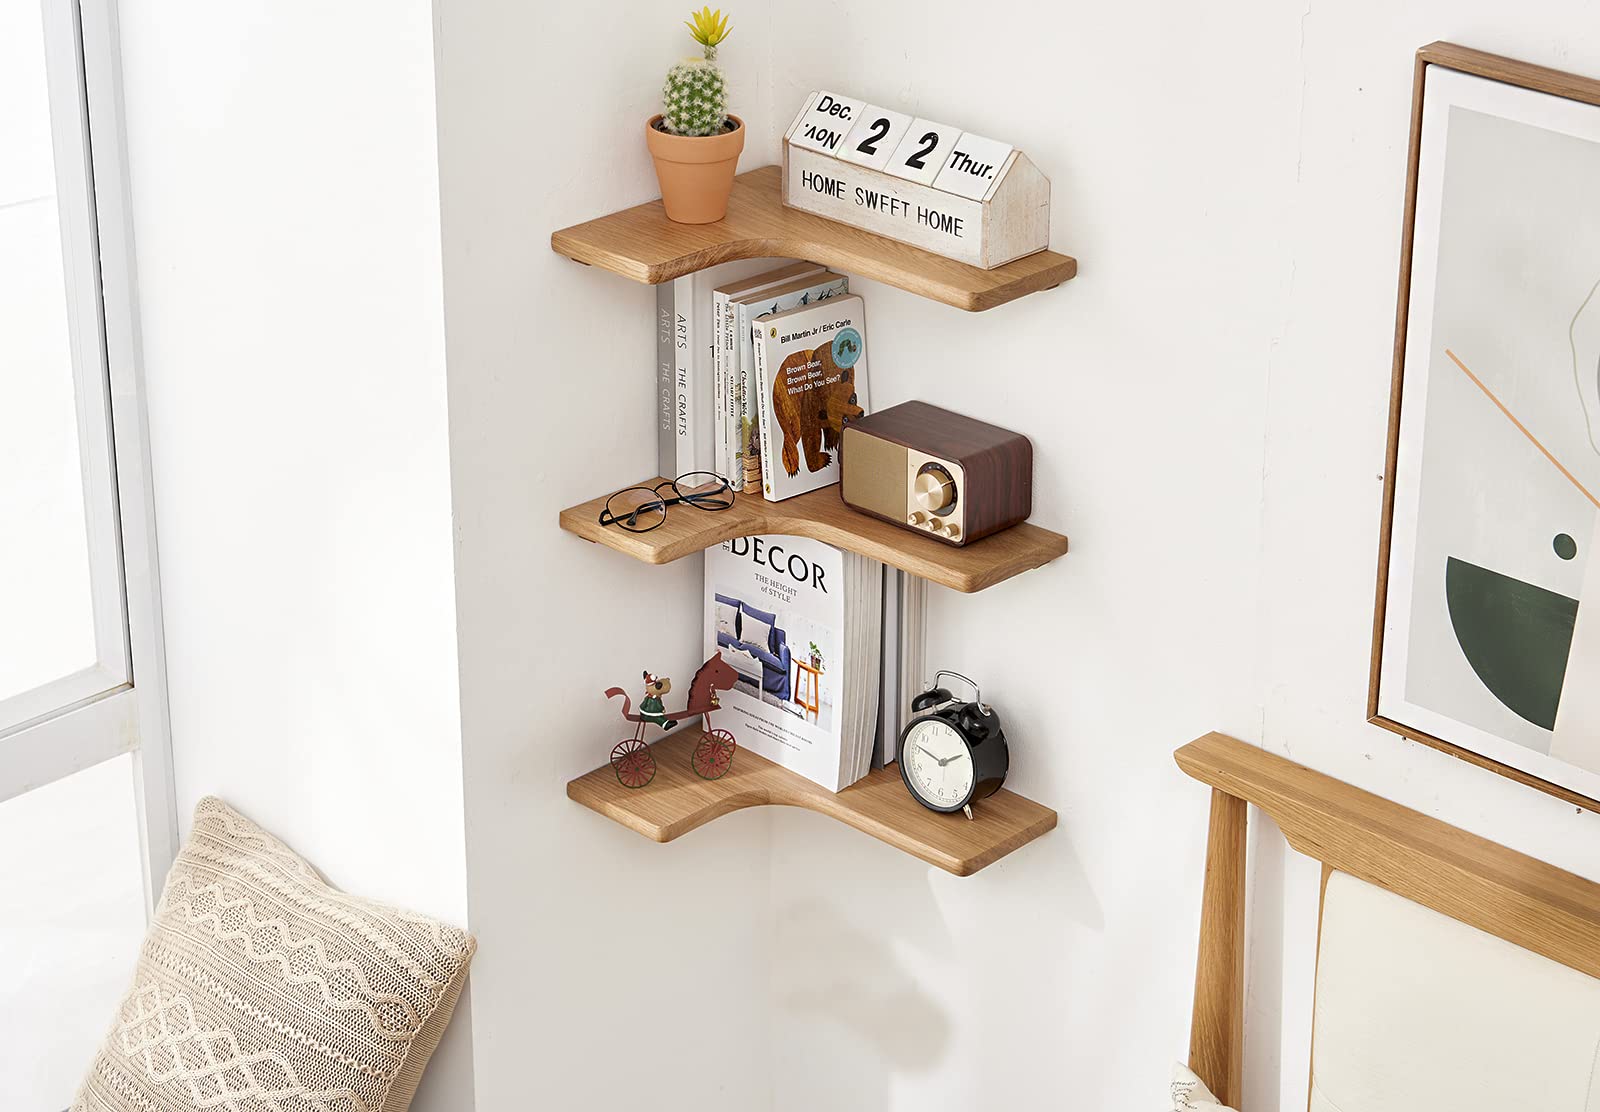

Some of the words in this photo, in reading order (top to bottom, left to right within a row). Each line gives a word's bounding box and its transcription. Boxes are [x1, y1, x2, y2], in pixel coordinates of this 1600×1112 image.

[816, 95, 852, 121] Dec.
[804, 123, 842, 150] Nov.
[856, 118, 890, 156] 2
[904, 132, 939, 170] 2
[949, 151, 993, 180] Thur.
[802, 170, 847, 200] HOME
[917, 206, 964, 238] HOME
[661, 307, 671, 344] ARTS
[677, 313, 687, 349] ARTS
[780, 335, 791, 344] Bill
[791, 329, 811, 341] Martin
[812, 327, 818, 336] Jr
[822, 323, 835, 332] Eric
[835, 319, 852, 329] Carle
[662, 362, 670, 383] THE
[678, 367, 687, 389] THE
[786, 364, 806, 375] Brown
[806, 360, 822, 368] Bear,
[787, 374, 807, 385] Brown
[807, 370, 823, 379] Bear,
[787, 385, 804, 395] What
[804, 383, 813, 391] Do
[813, 379, 825, 388] You
[825, 374, 841, 385] See?
[662, 388, 671, 430] CRAFTS
[678, 393, 687, 436] CRAFTS
[731, 536, 828, 594] DECOR
[754, 572, 769, 585] THE
[769, 579, 798, 597] HEIGHT
[760, 585, 768, 593] of
[768, 587, 791, 603] STYLE
